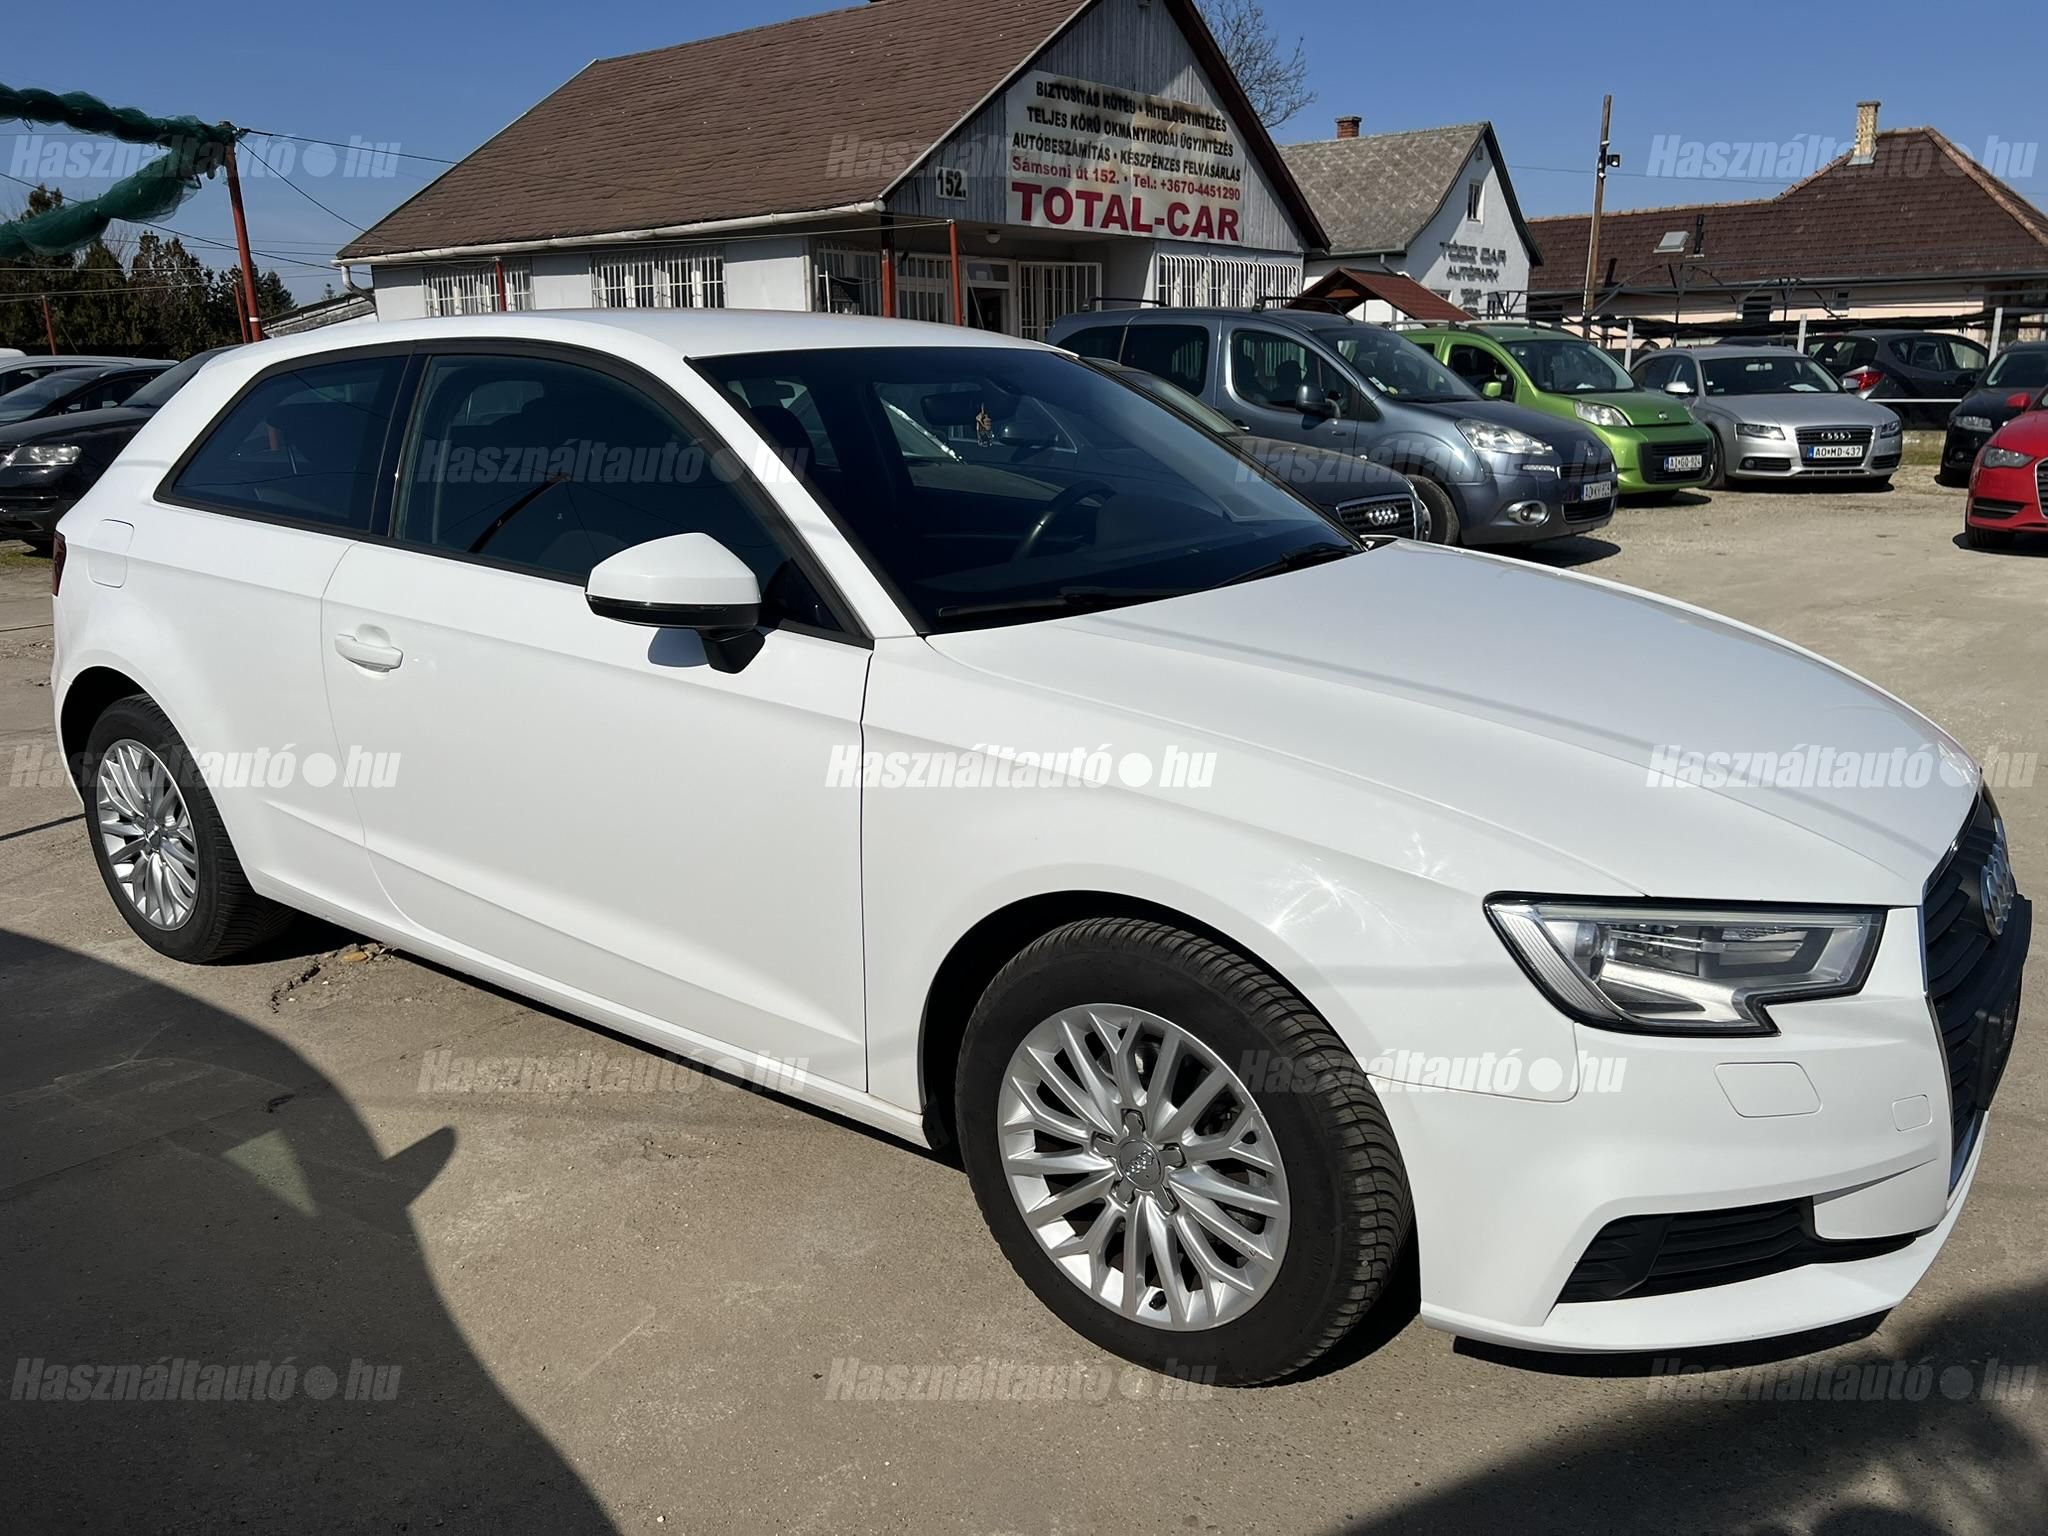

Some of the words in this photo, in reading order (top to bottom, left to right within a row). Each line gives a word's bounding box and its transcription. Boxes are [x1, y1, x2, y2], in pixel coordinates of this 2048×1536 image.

[1036, 80, 1100, 107] BIZTOSÍTÁS
[1027, 106, 1068, 129] TELJES
[1103, 120, 1178, 148] OKMÁNYIRODAI
[1180, 133, 1233, 157] ÜGYINTÉZÉS
[1012, 132, 1111, 162] AUTÓBESZÁMÍTÁS
[1120, 149, 1181, 173] KÉSZPÉNZES
[1183, 160, 1241, 182] FELVÁSÁRLÁS
[1012, 156, 1071, 179] Sámsoni
[1076, 164, 1089, 181] út
[1093, 167, 1120, 185] 152.
[1133, 174, 1157, 190] Tel.:
[1160, 180, 1241, 201] +3670-4451290
[937, 168, 967, 198] 152.
[1011, 181, 1240, 242] TOTAL-CAR
